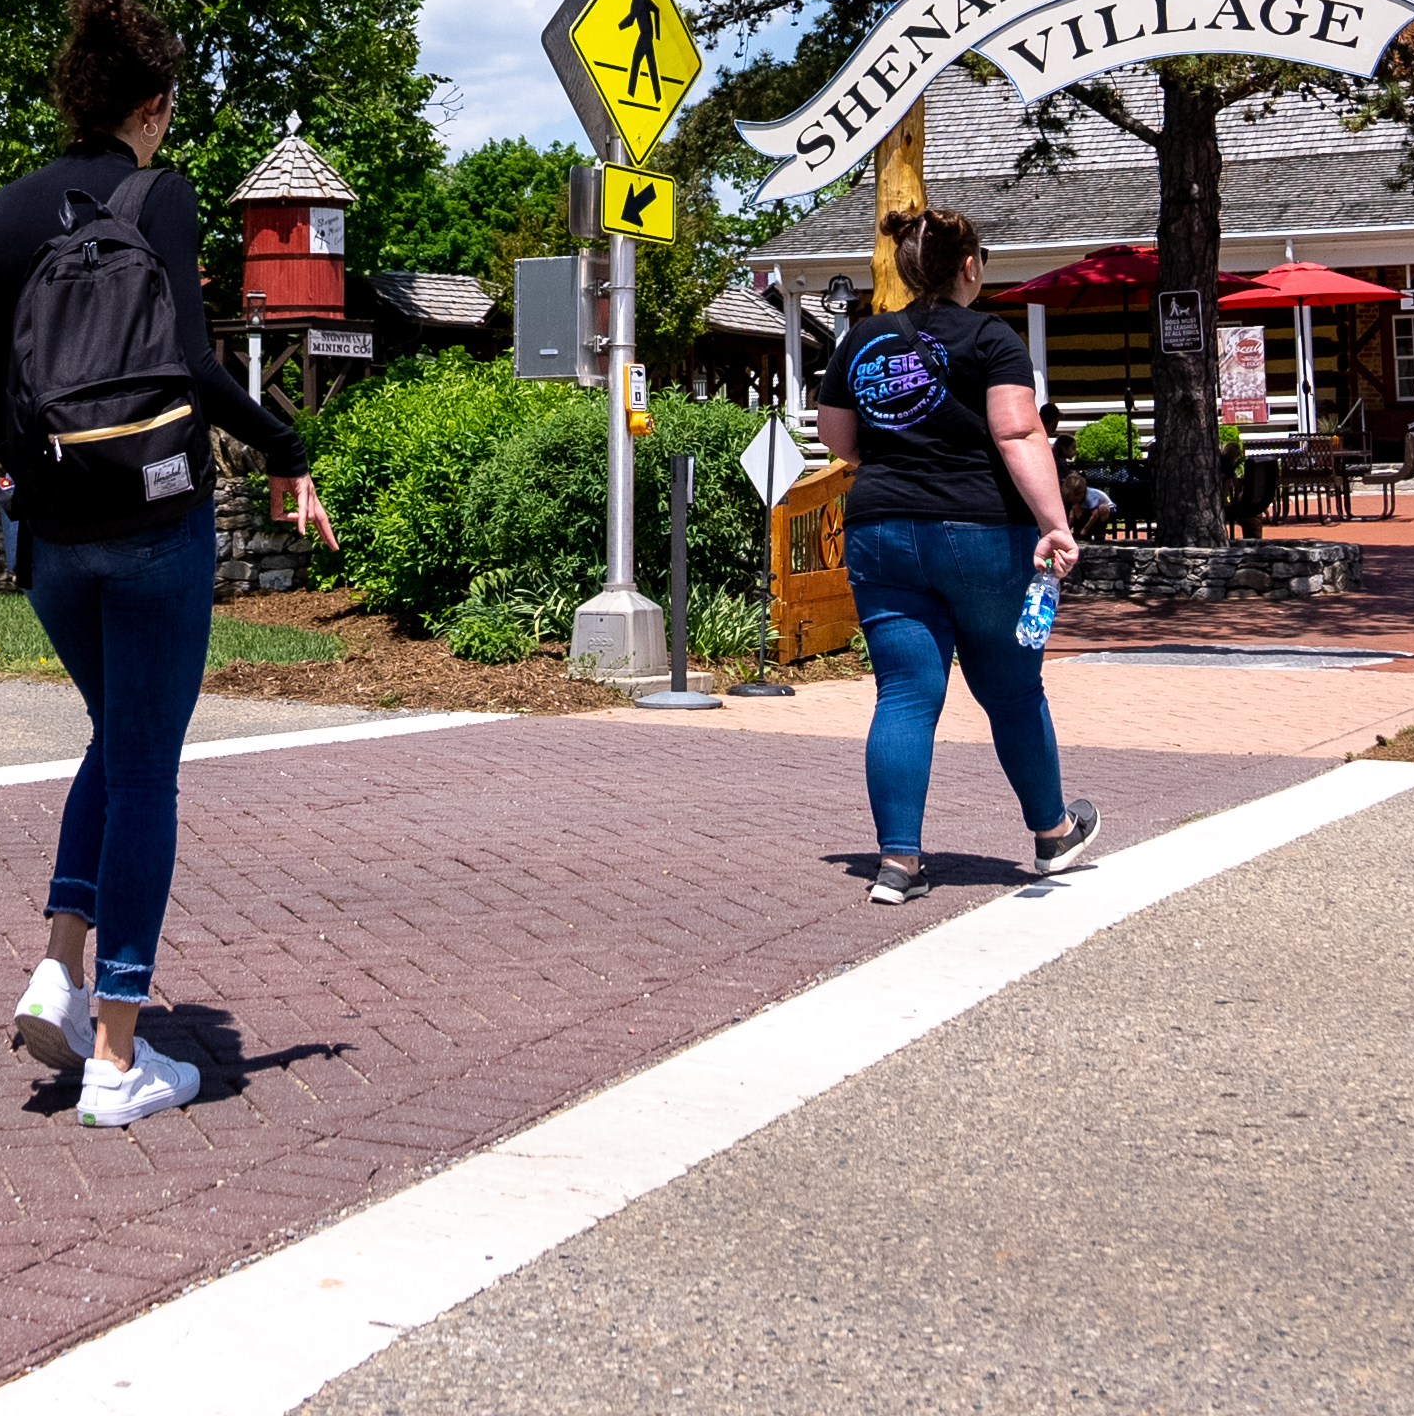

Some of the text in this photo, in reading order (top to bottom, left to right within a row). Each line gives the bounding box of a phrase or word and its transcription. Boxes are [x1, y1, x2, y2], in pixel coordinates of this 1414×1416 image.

[312, 343, 350, 353] MINING
[853, 355, 885, 391] get
[854, 372, 932, 405] TRACKE
